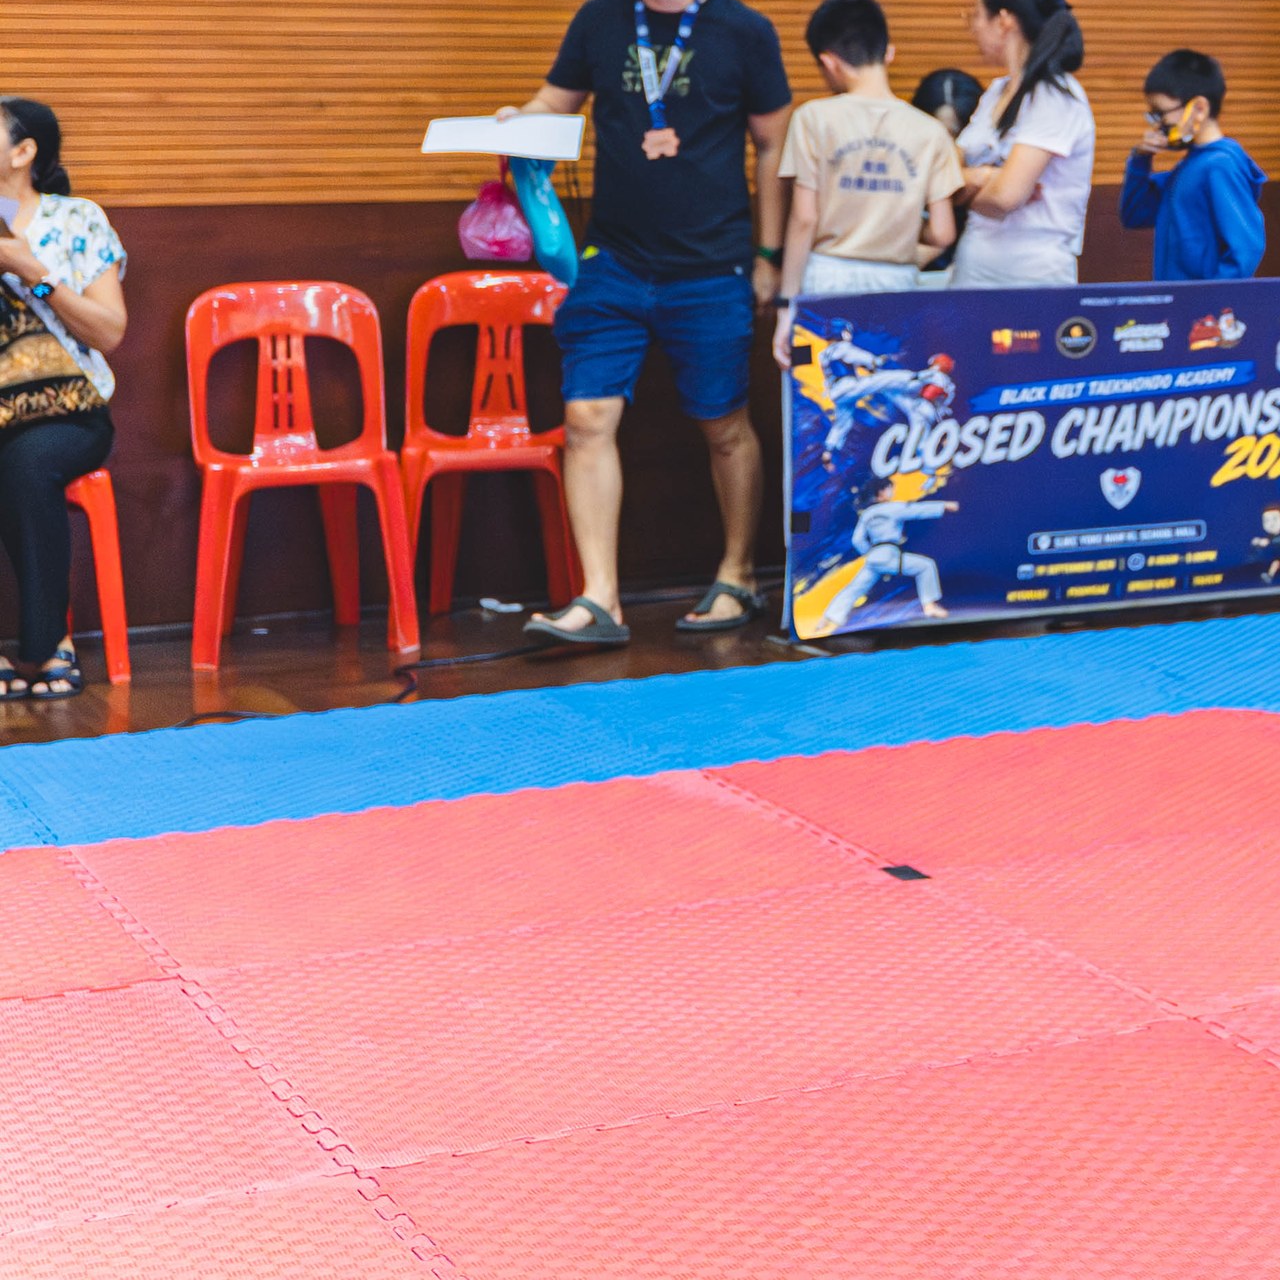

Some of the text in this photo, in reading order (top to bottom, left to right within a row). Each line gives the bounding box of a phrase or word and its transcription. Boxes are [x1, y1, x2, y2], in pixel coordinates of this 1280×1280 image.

[1000, 385, 1046, 406] BLACK
[1050, 381, 1085, 401] BELT
[1175, 367, 1236, 388] ACADEMY
[871, 410, 1046, 478] CLOSED
